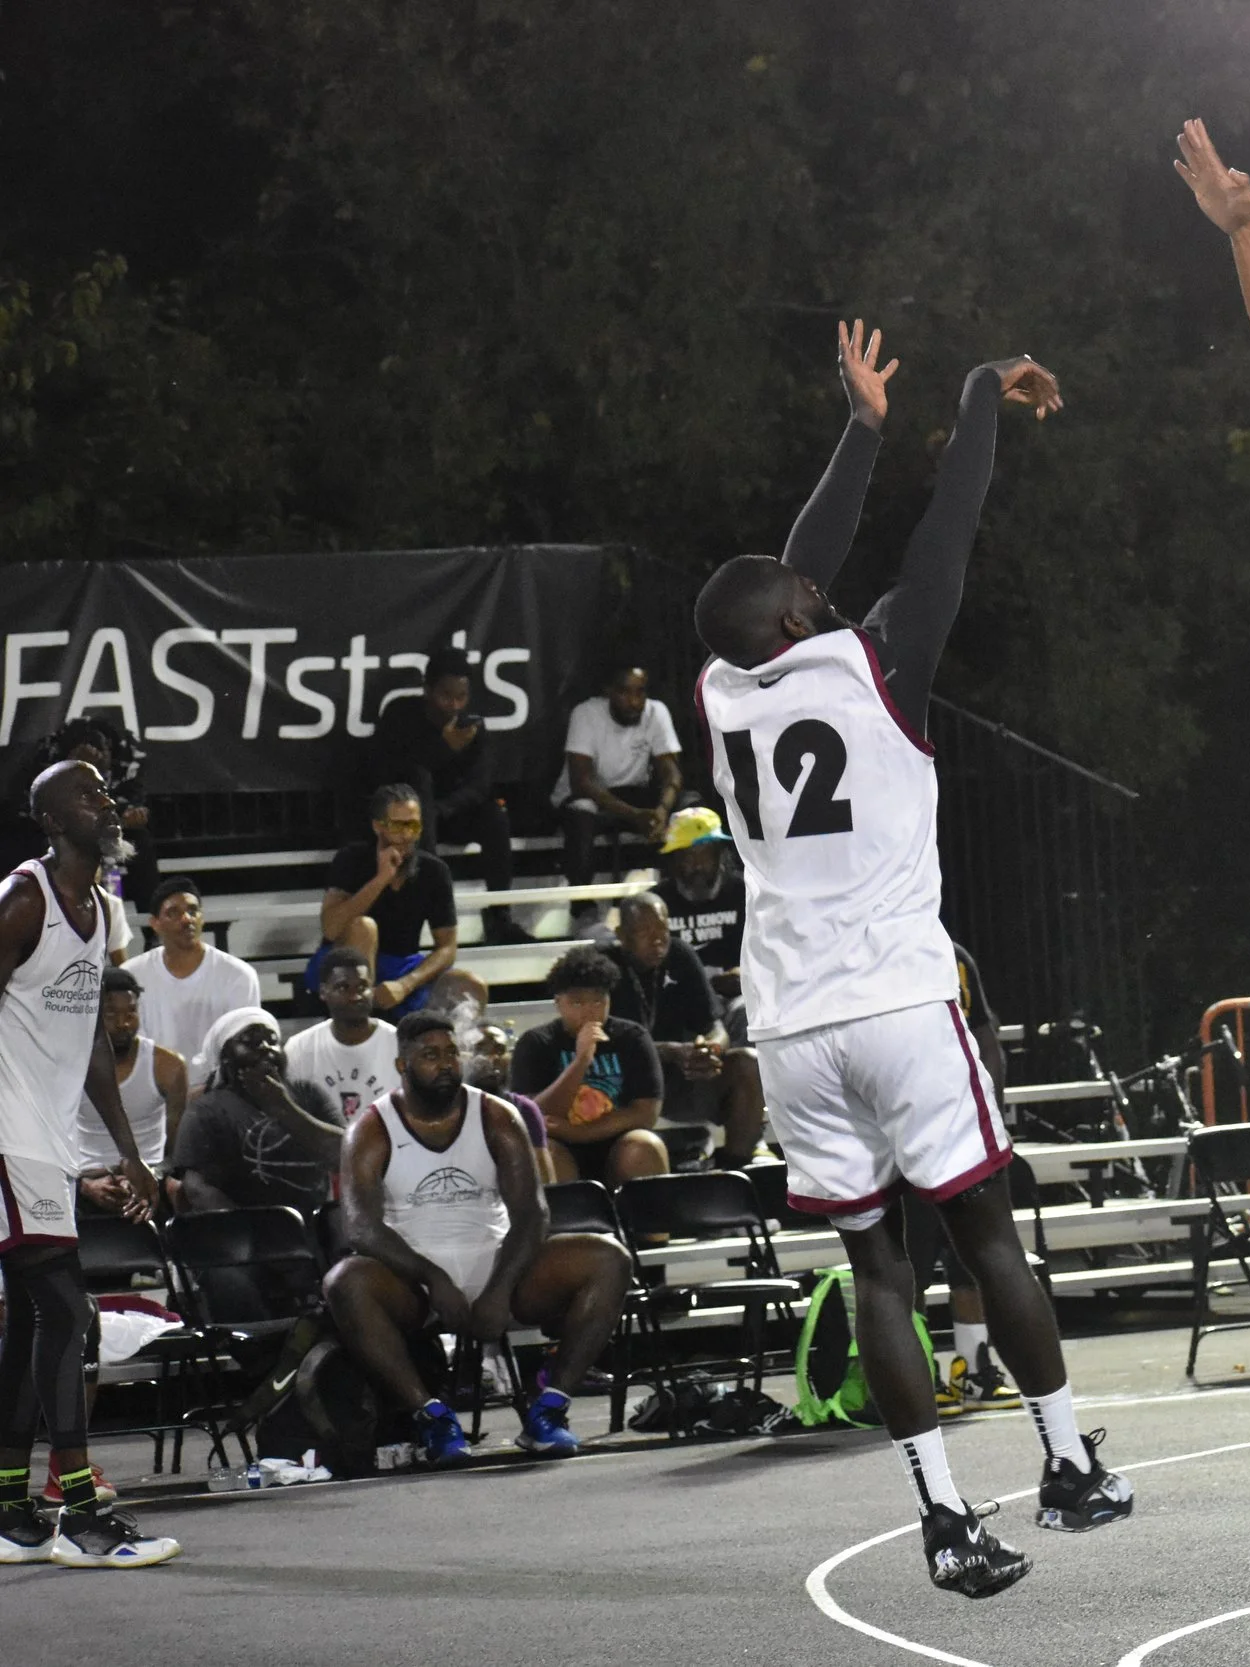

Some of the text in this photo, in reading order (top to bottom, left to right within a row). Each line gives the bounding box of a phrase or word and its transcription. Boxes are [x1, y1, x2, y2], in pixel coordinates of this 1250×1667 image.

[0, 627, 531, 746] FASTstas
[722, 718, 853, 841] 12
[41, 985, 77, 1003] George
